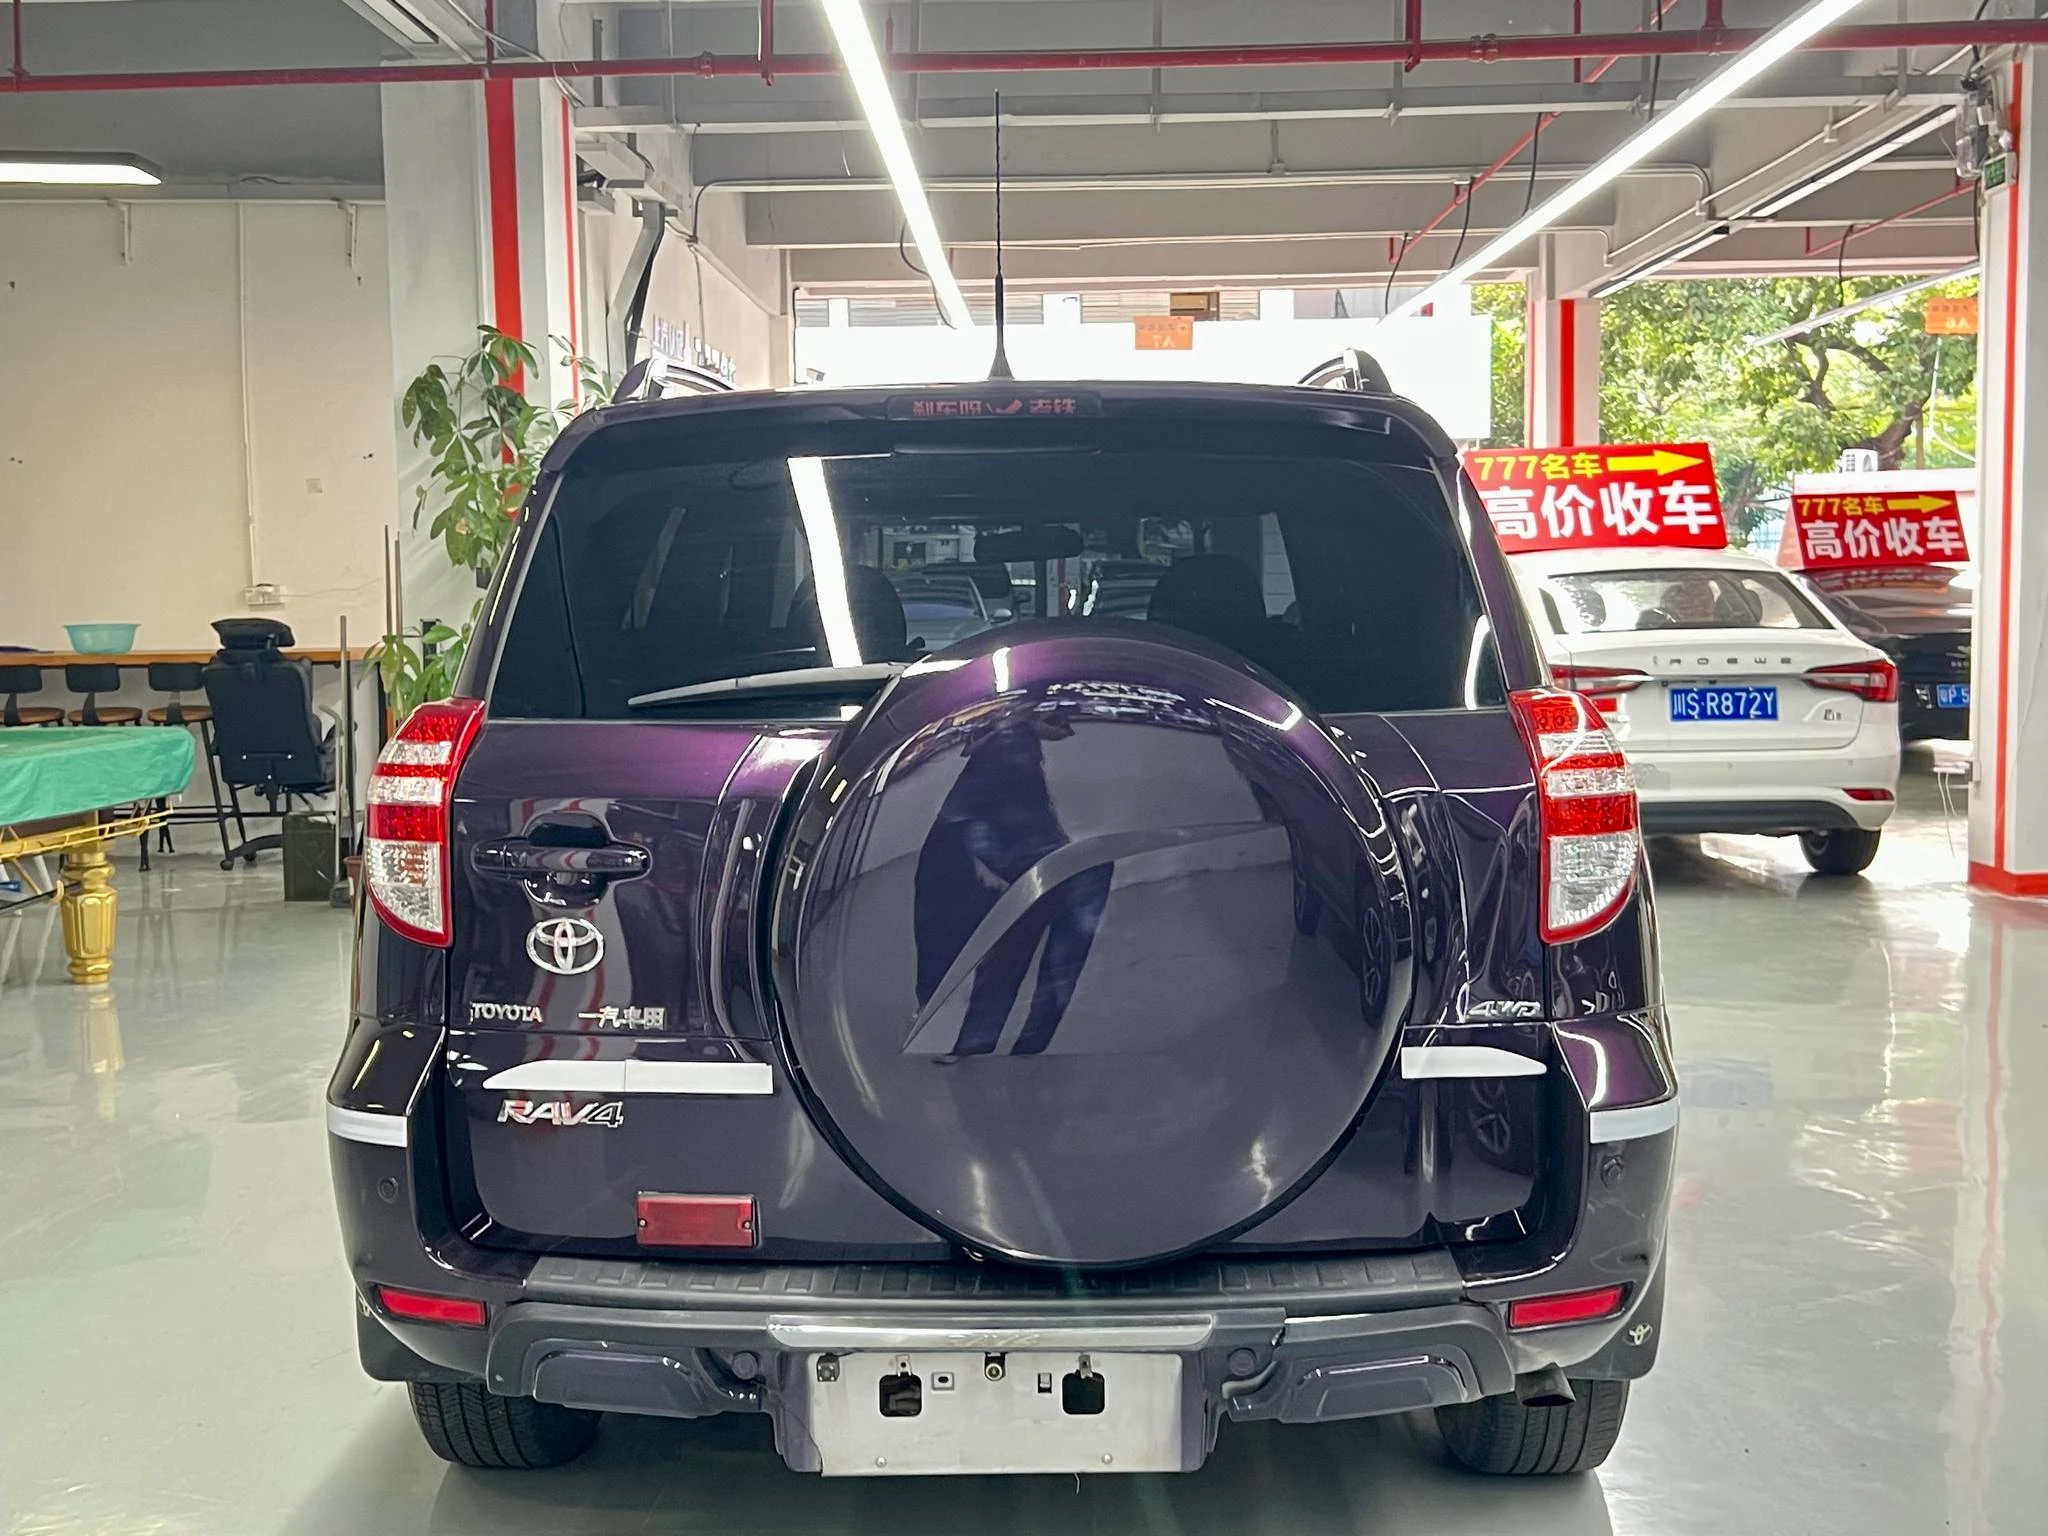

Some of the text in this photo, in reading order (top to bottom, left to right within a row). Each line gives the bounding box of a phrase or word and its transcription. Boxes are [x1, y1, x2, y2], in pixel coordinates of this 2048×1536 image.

[1475, 453, 1602, 481] 777名车
[1480, 480, 1718, 539] 高价收车
[1797, 496, 1885, 517] 777名车
[1801, 516, 1964, 560] 高价收车
[471, 1002, 543, 1023] TOYOTA
[1468, 1000, 1541, 1018] 4WD
[497, 1099, 624, 1128] RAV4
